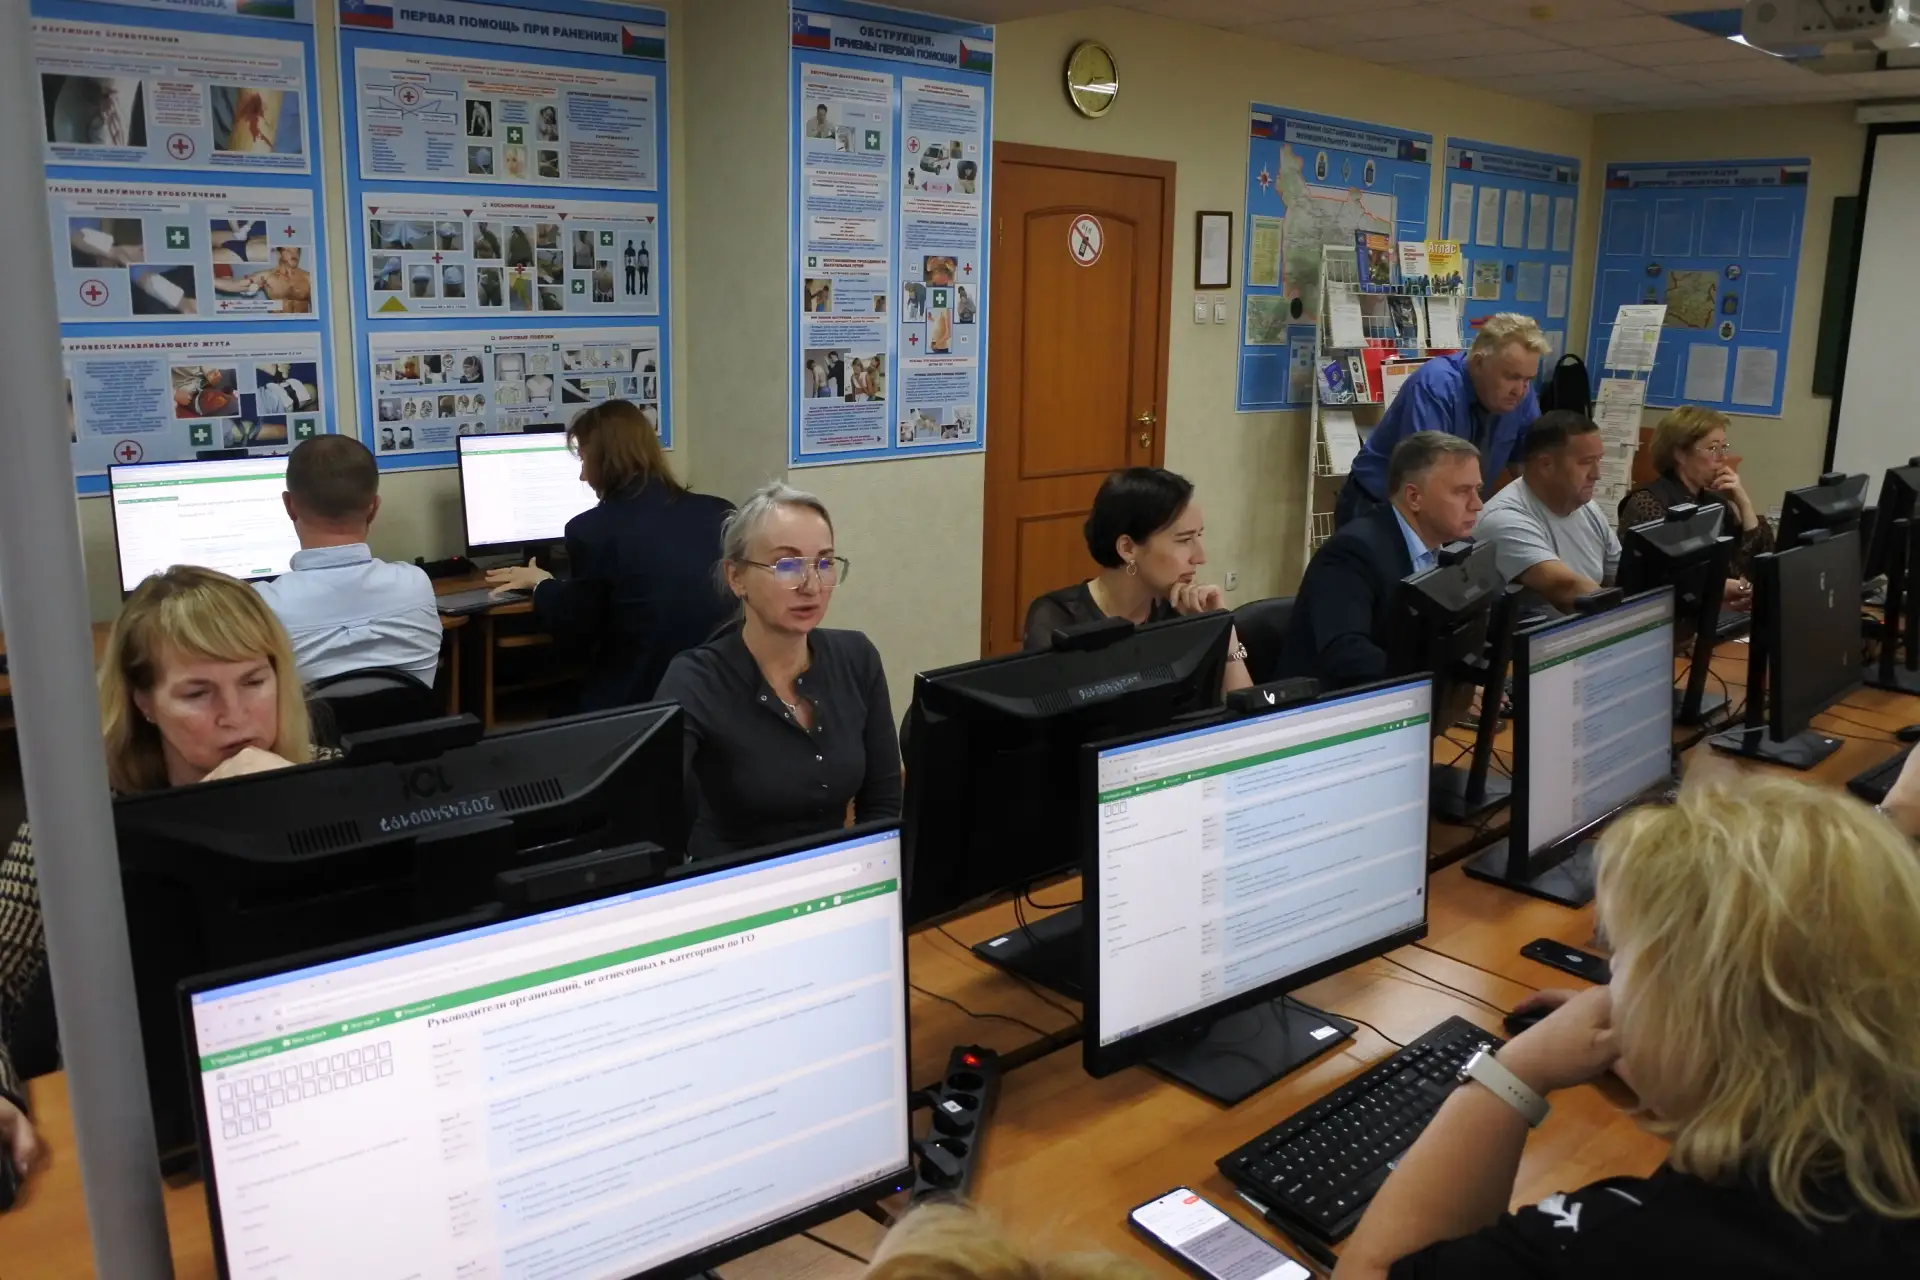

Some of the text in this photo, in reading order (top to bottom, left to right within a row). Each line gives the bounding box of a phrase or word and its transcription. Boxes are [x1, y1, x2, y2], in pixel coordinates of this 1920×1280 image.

[400, 9, 618, 43] ПЕРВАЯ ПОМОЩЬ ПРИ РАНЕНИЯХ
[48, 186, 93, 194] ТАНОВКИ
[427, 1002, 507, 1028] Руководители
[510, 980, 581, 1008] организаций,
[598, 961, 658, 982] отнесенных
[669, 943, 725, 963] категориям
[741, 933, 755, 945] ГО
